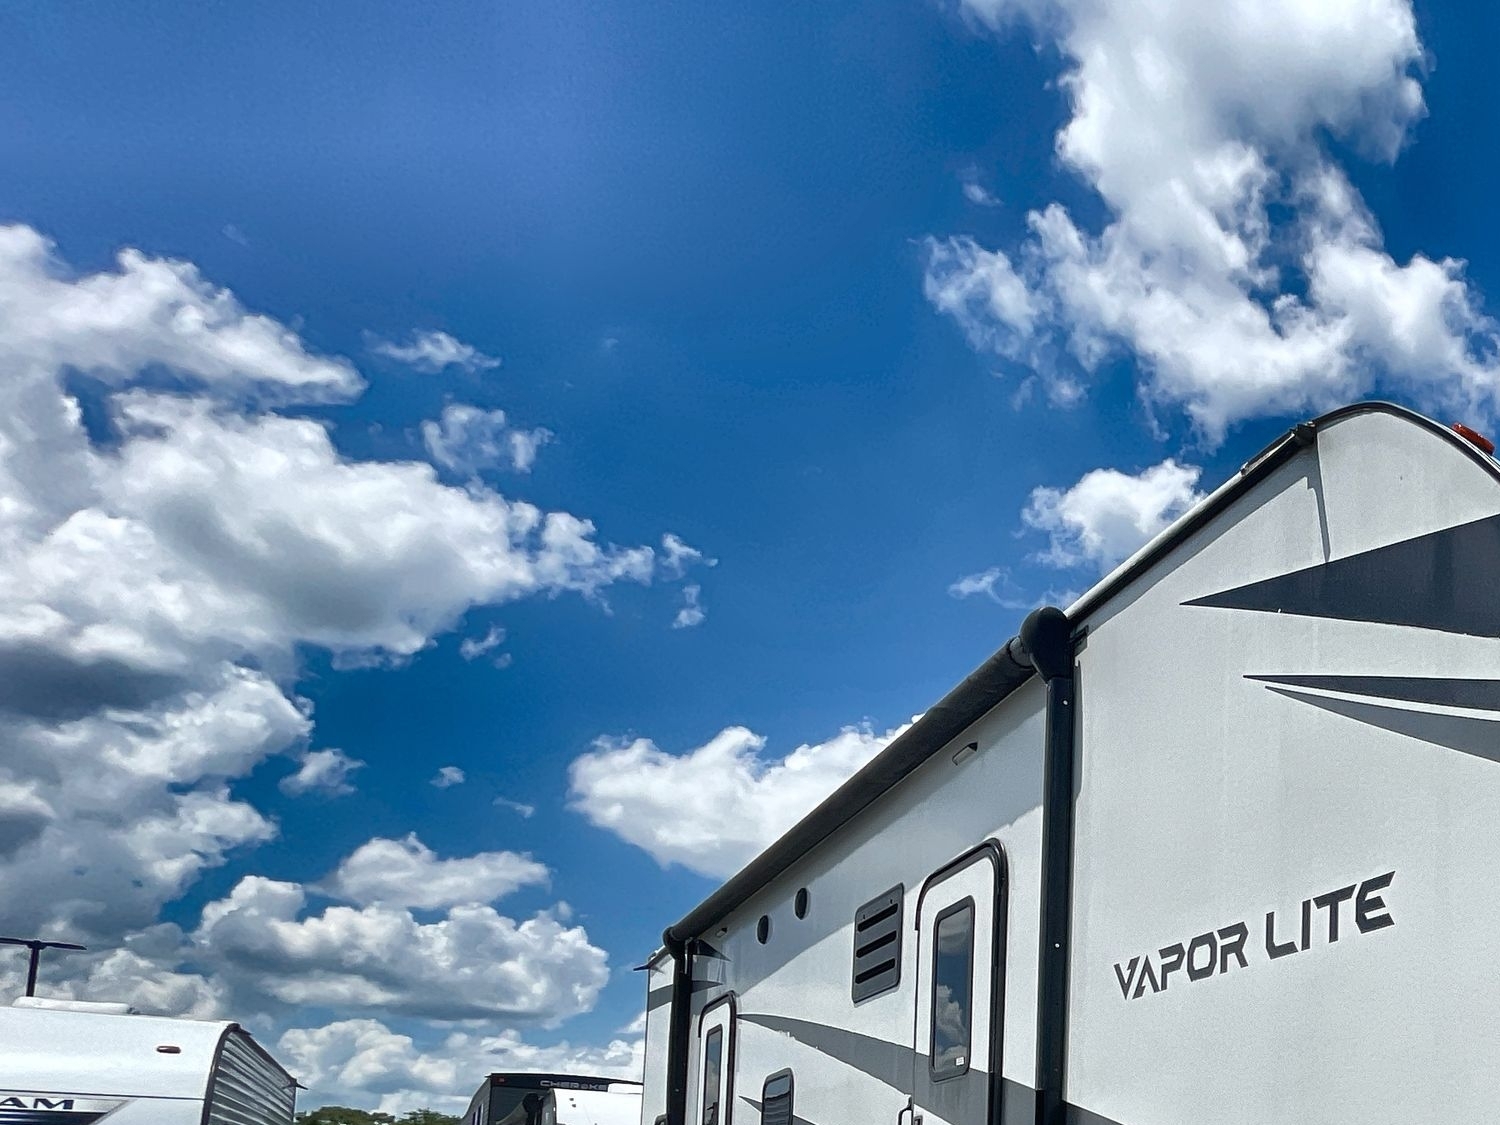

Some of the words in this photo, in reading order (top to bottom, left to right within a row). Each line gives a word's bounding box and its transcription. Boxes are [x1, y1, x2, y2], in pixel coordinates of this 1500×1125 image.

[1113, 921, 1249, 1000] VAPOR
[1266, 870, 1396, 960] LITE
[540, 1080, 608, 1091] CHEROKE
